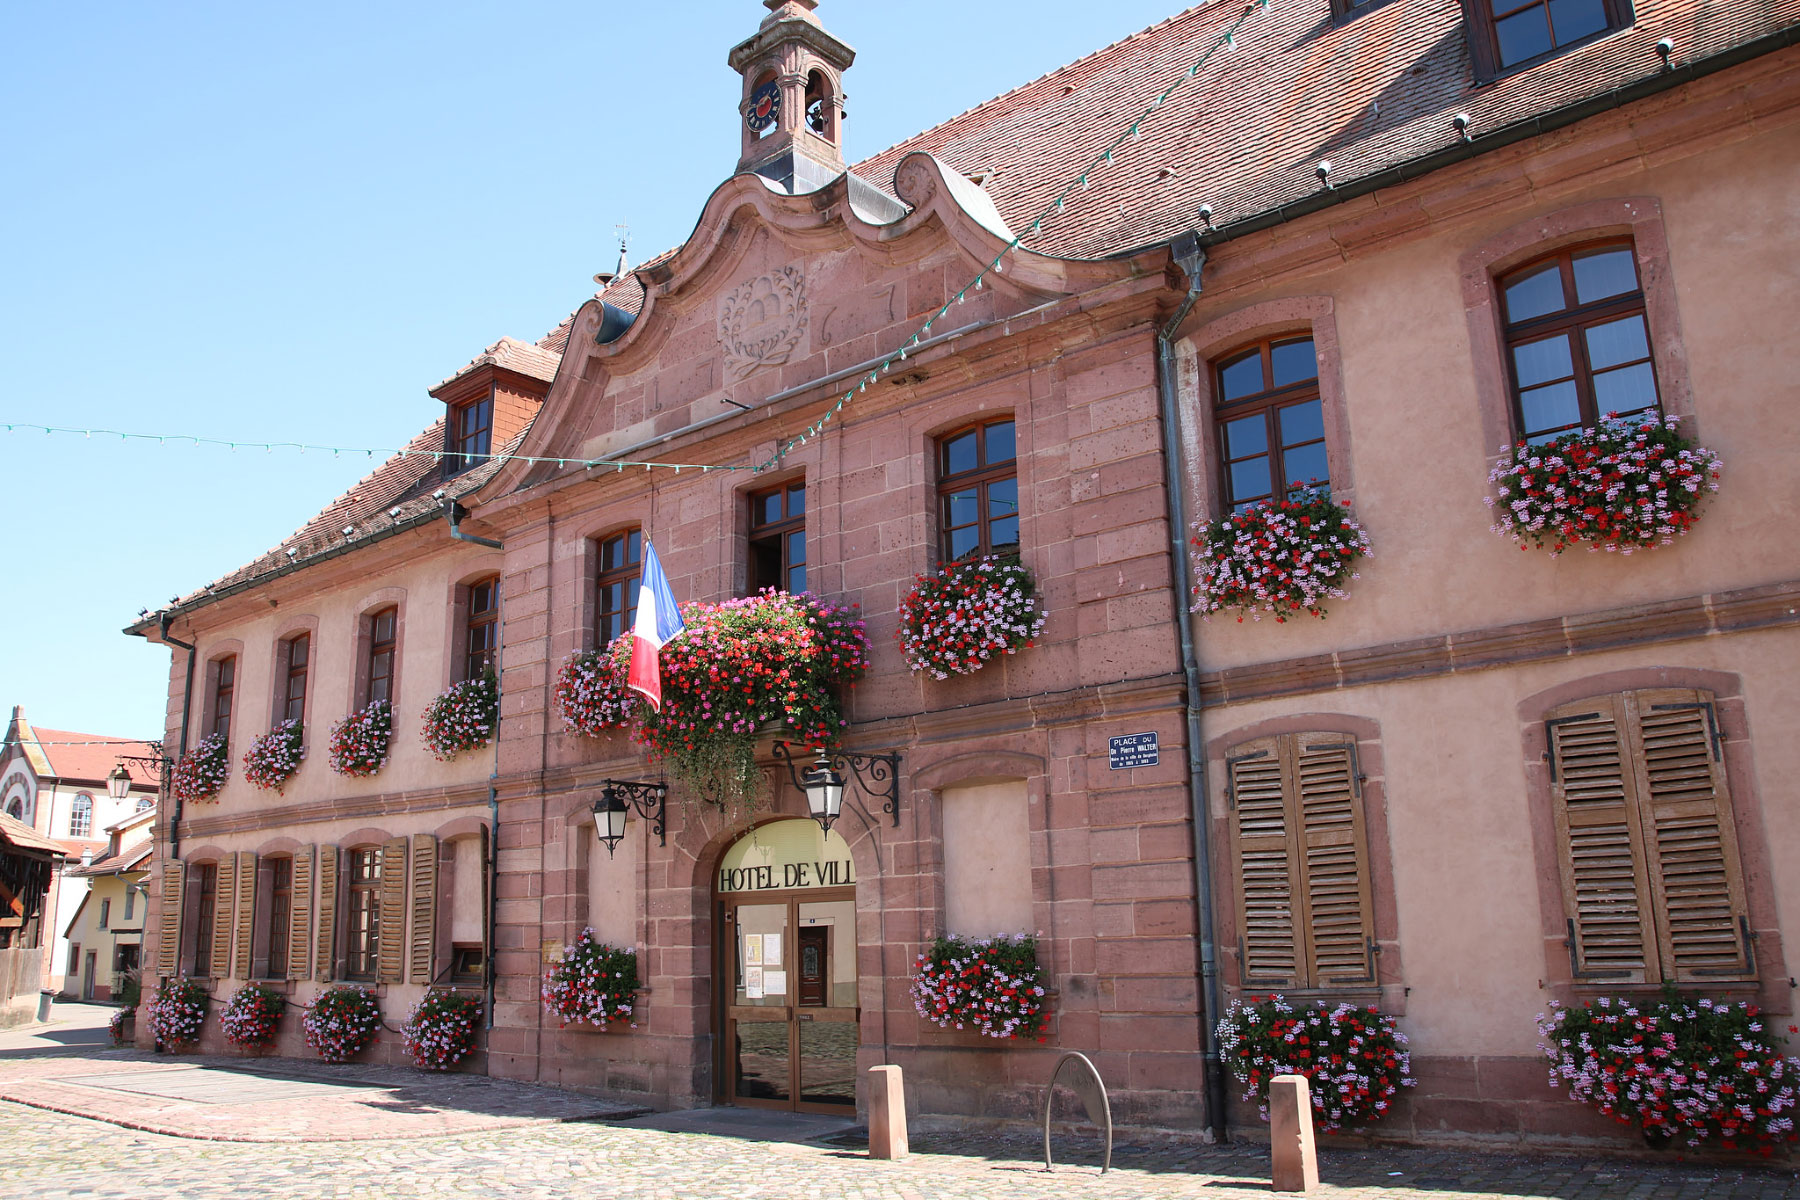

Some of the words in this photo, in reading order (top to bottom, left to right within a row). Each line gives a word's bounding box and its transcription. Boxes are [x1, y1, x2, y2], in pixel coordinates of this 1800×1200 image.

[1114, 737, 1137, 746] PLACE
[1137, 744, 1156, 752] WALTER
[720, 865, 780, 891] HOTEL
[783, 863, 810, 887] DE
